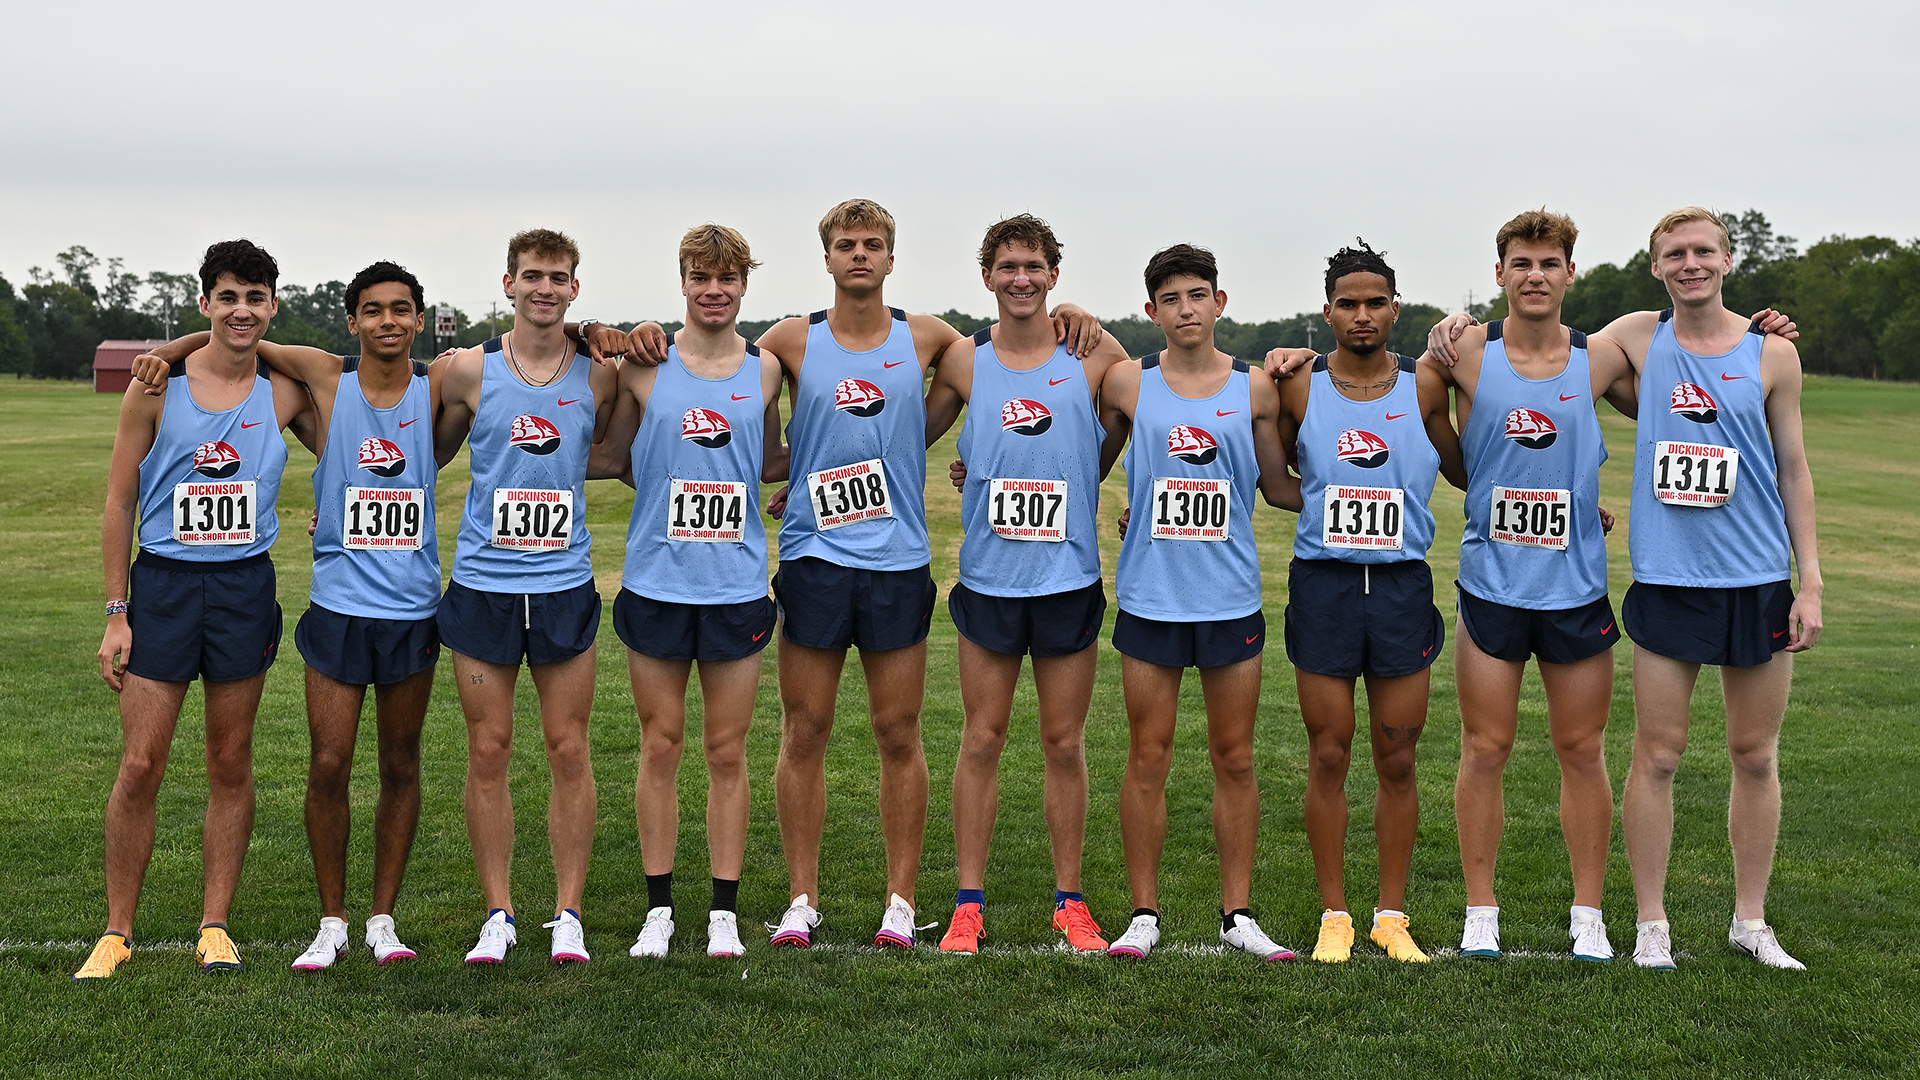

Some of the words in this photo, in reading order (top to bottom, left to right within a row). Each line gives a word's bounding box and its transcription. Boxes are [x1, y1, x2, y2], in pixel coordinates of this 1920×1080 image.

[1668, 444, 1724, 458] DICKINSON
[820, 464, 870, 483] DICKINSON
[1658, 456, 1729, 494] 1311
[188, 484, 242, 495] DICKINSON
[683, 482, 734, 494] DICKINSON
[1003, 481, 1054, 492] DICKINSON
[1167, 480, 1218, 492] DICKINSON
[359, 490, 411, 501] DICKINSON
[508, 491, 560, 502] DICKINSON
[816, 474, 885, 517] 1308
[1339, 488, 1391, 501] DICKINSON
[1505, 490, 1558, 501] DICKINSON
[1658, 491, 1702, 501] LONG-SHORT
[1703, 495, 1727, 503] INVITE
[180, 496, 250, 531] 1301
[673, 494, 742, 529] 1304
[994, 493, 1062, 527] 1307
[1158, 492, 1225, 527] 1300
[350, 502, 419, 536] 1309
[498, 503, 568, 538] 1302
[822, 512, 864, 526] LONG-SHORT
[865, 507, 886, 517] INVITE
[1329, 500, 1398, 536] 1310
[1495, 500, 1566, 537] 1305
[180, 533, 226, 541] LONG-SHORT
[227, 532, 250, 540] INVITE
[673, 529, 716, 538] LONG-SHORT
[994, 527, 1037, 536] LONG-SHORT
[1038, 529, 1059, 537] INVITE
[1157, 527, 1201, 536] LONG-SHORT
[1495, 532, 1539, 543] LONG-SHORT
[349, 537, 394, 546] LONG-SHORT
[497, 538, 541, 546] LONG-SHORT
[1329, 535, 1373, 544] LONG-SHORT
[1374, 538, 1396, 546] INVITE
